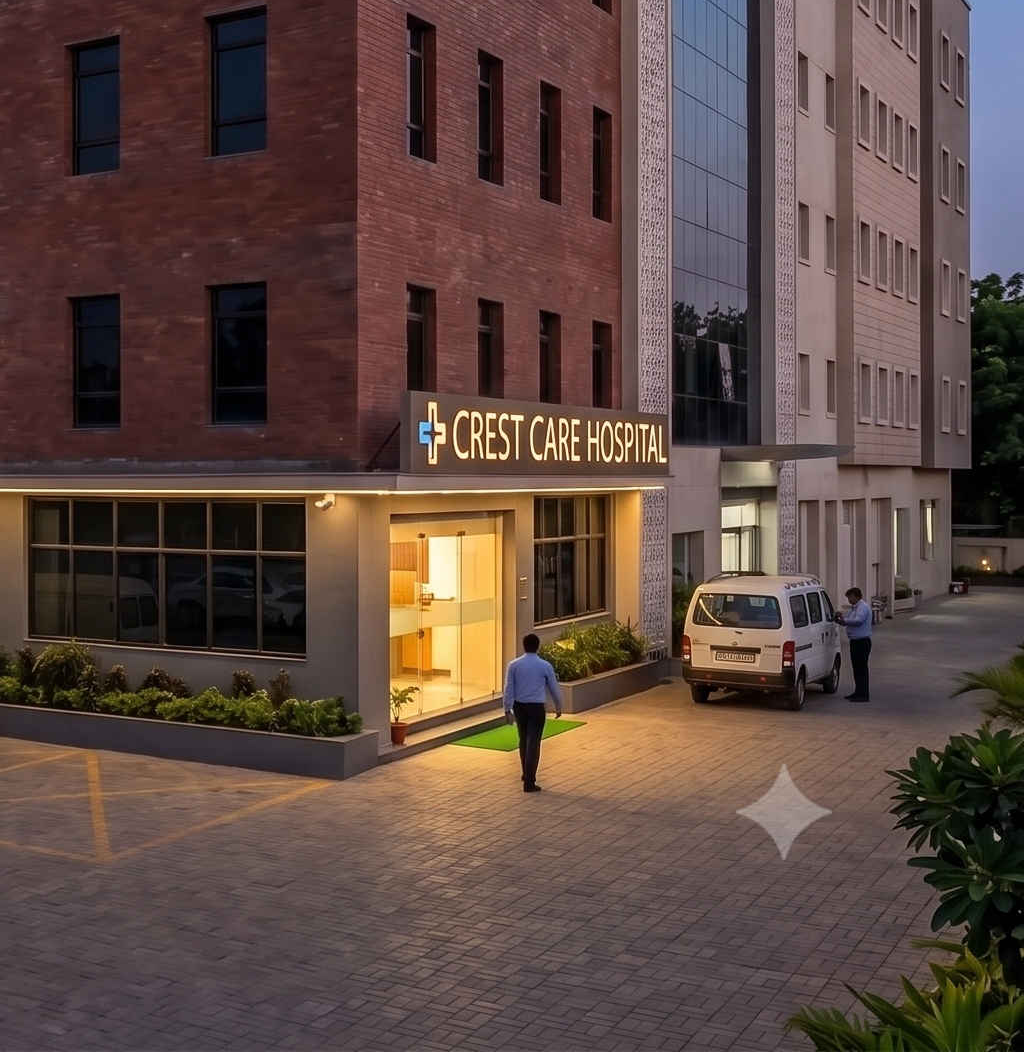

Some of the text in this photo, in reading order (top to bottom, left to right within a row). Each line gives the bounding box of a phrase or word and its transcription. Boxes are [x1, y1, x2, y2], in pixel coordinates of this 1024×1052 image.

[452, 409, 668, 464] CREST CARE HOSPITAL
